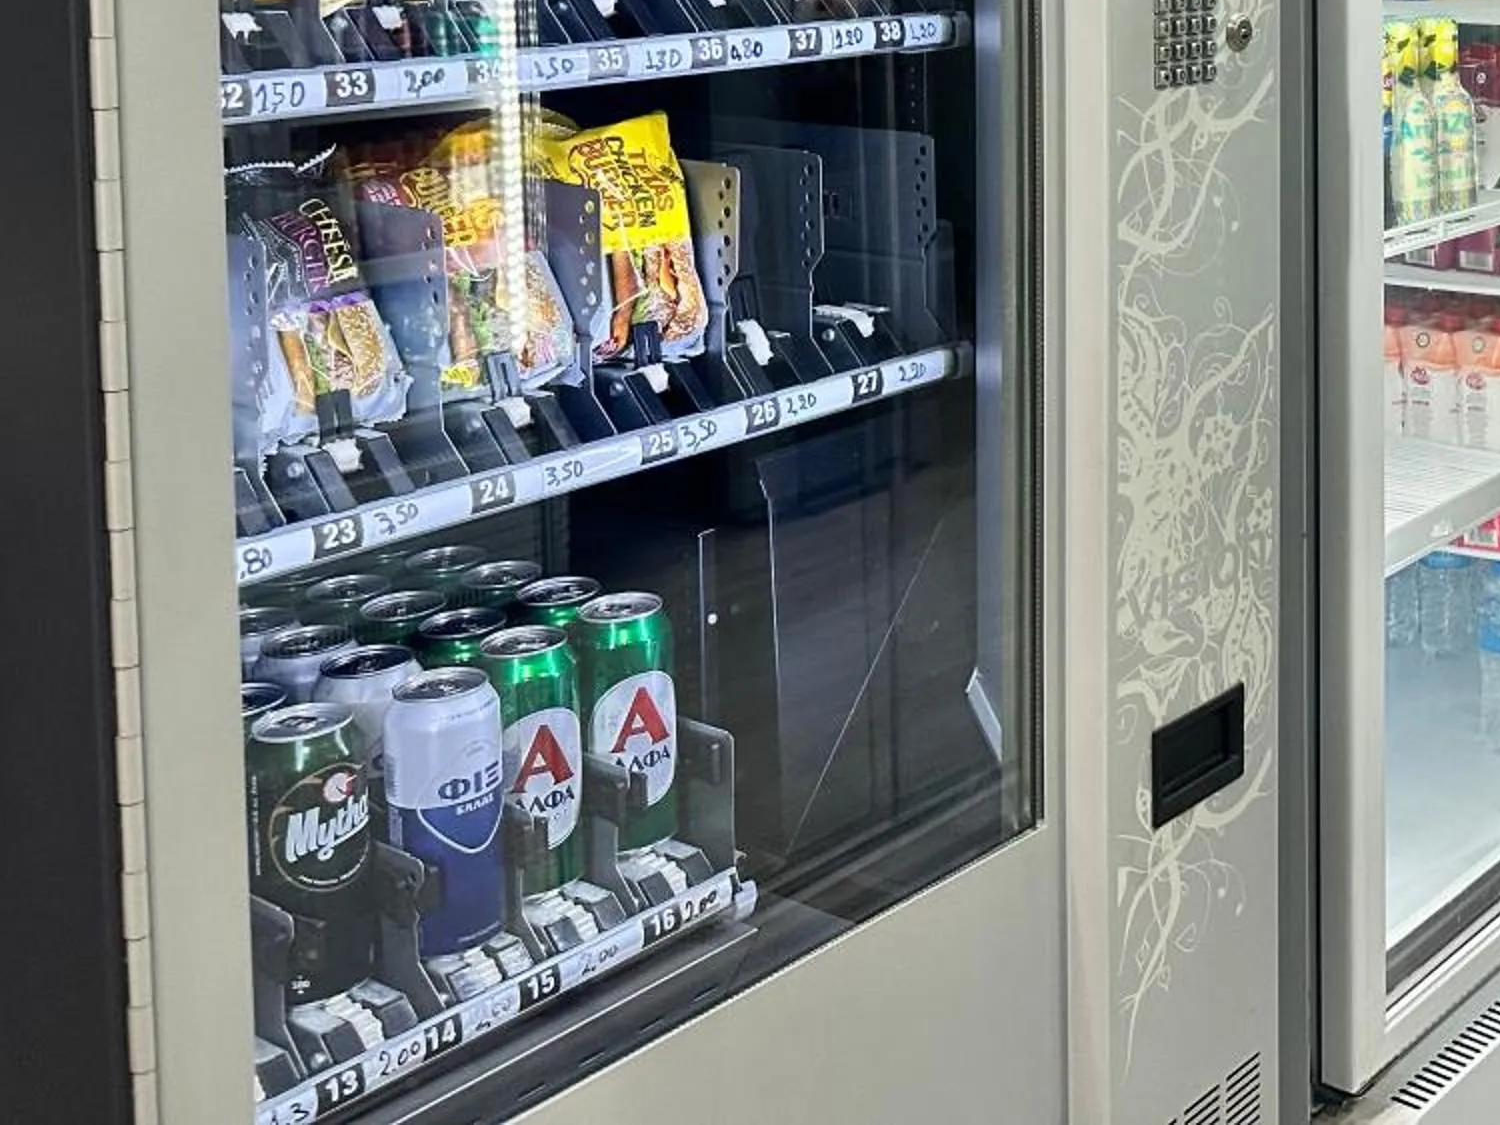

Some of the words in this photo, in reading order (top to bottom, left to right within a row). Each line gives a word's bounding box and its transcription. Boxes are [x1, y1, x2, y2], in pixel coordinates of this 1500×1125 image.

[254, 81, 306, 115] 1,50
[335, 72, 369, 98] 33
[599, 49, 623, 71] 35
[699, 38, 723, 60] 36
[795, 27, 817, 50] 37
[881, 21, 901, 43] 38
[604, 135, 657, 230] CHICKEN
[322, 519, 357, 549] 23
[373, 501, 420, 536] 3,50
[479, 477, 510, 504] 24
[544, 458, 584, 488] 3,50
[648, 432, 674, 455] 25
[680, 419, 718, 451] 3,50
[750, 404, 778, 427] 26
[857, 371, 880, 395] 27
[324, 1069, 360, 1103] 13
[378, 1040, 422, 1077] 2.00
[426, 1022, 457, 1051] 14
[527, 970, 556, 1000] 15
[650, 908, 675, 936] 16
